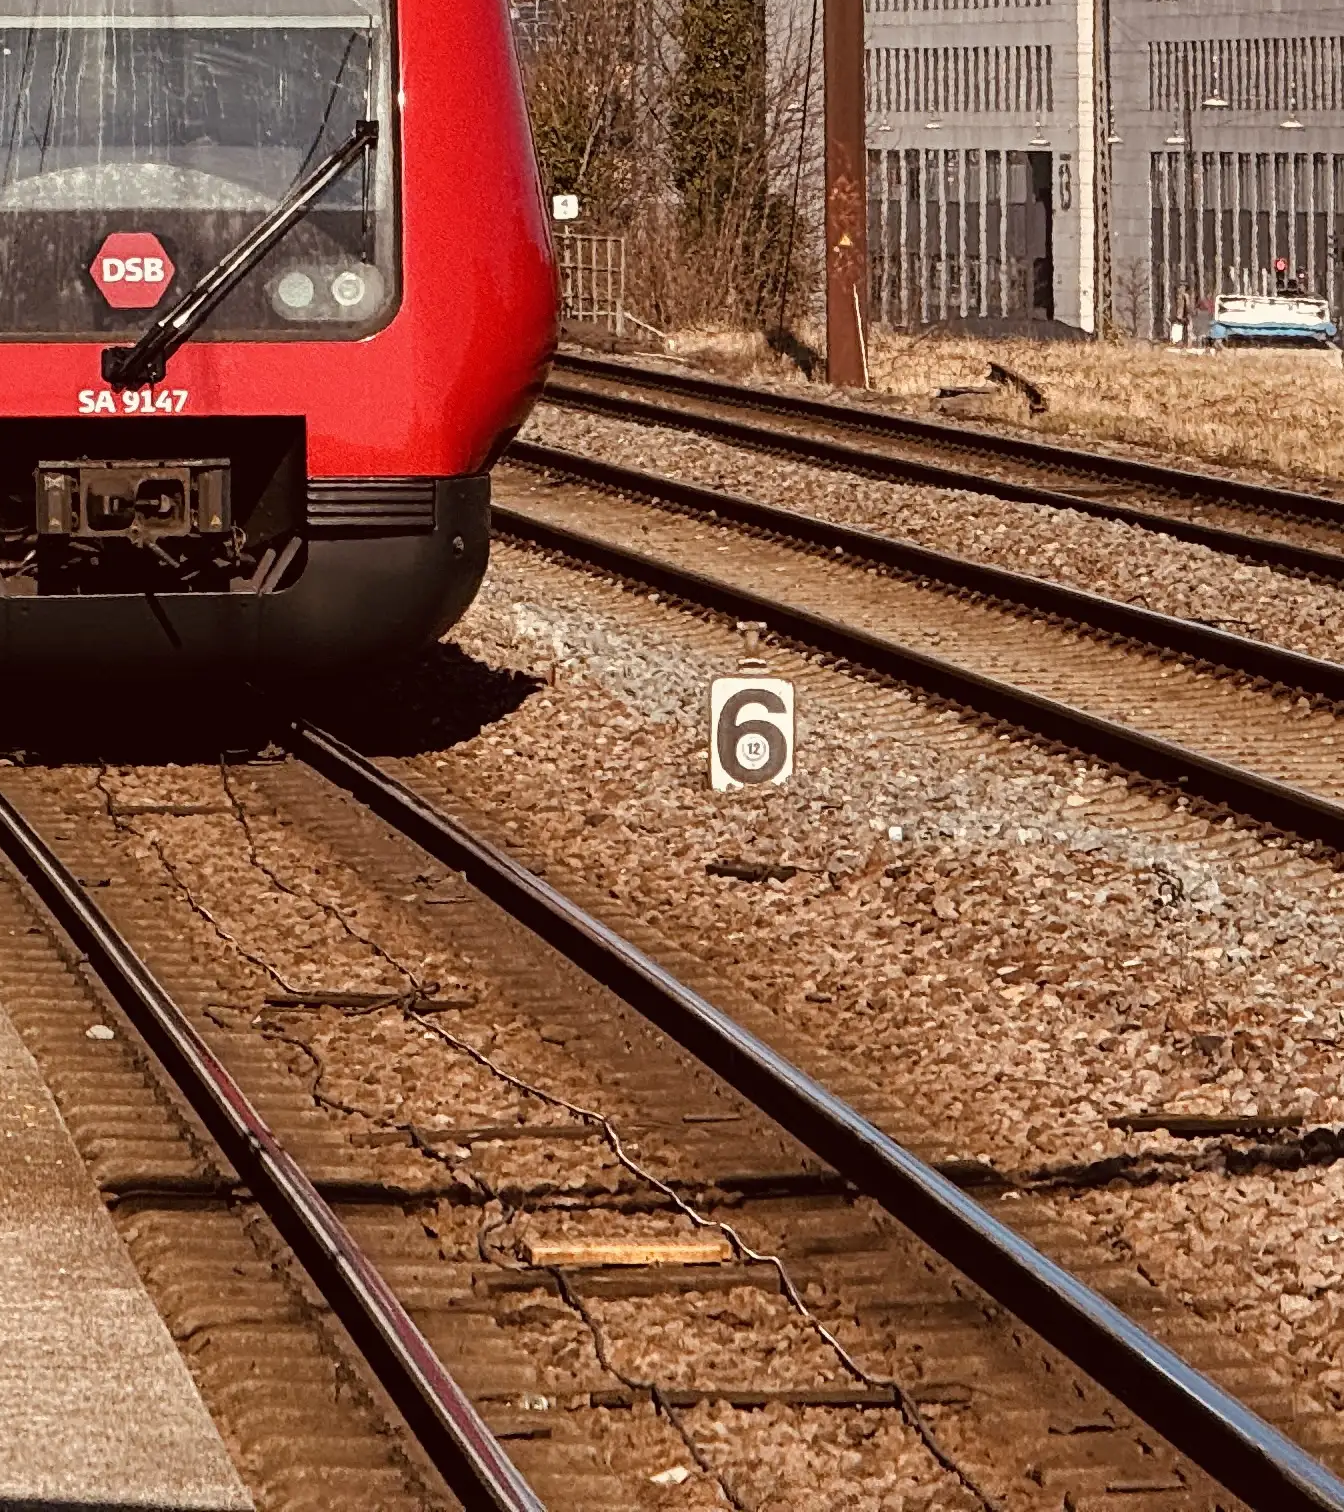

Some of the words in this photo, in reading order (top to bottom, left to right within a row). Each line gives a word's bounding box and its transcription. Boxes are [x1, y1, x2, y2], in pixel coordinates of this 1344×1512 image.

[102, 258, 165, 282] DSB
[78, 389, 116, 413] SA
[123, 389, 188, 413] 9147
[717, 688, 787, 784] 6
